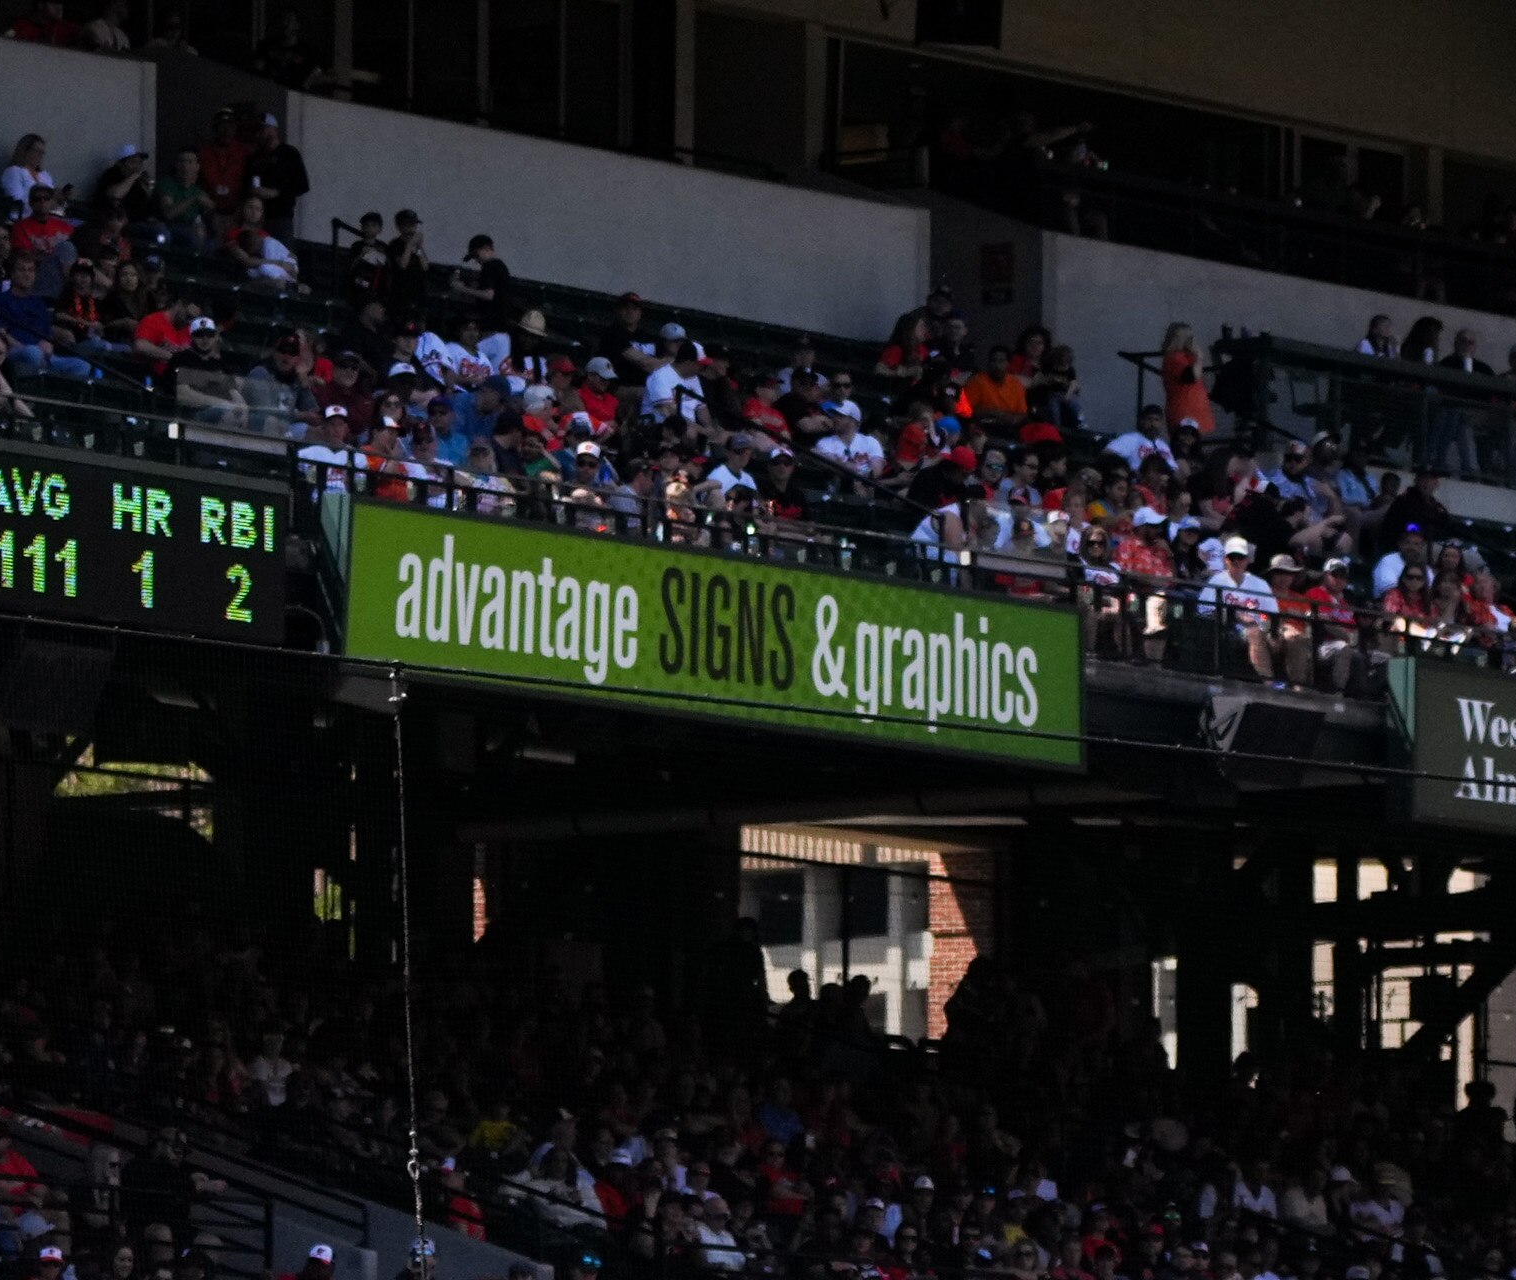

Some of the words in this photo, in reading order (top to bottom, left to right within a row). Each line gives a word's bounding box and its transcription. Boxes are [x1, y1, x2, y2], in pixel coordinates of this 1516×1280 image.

[112, 483, 173, 537] HR
[200, 496, 274, 552] RBI
[132, 550, 154, 608] 1
[226, 563, 252, 623] 2
[395, 534, 639, 685] advantage
[659, 566, 795, 691] SIGNS
